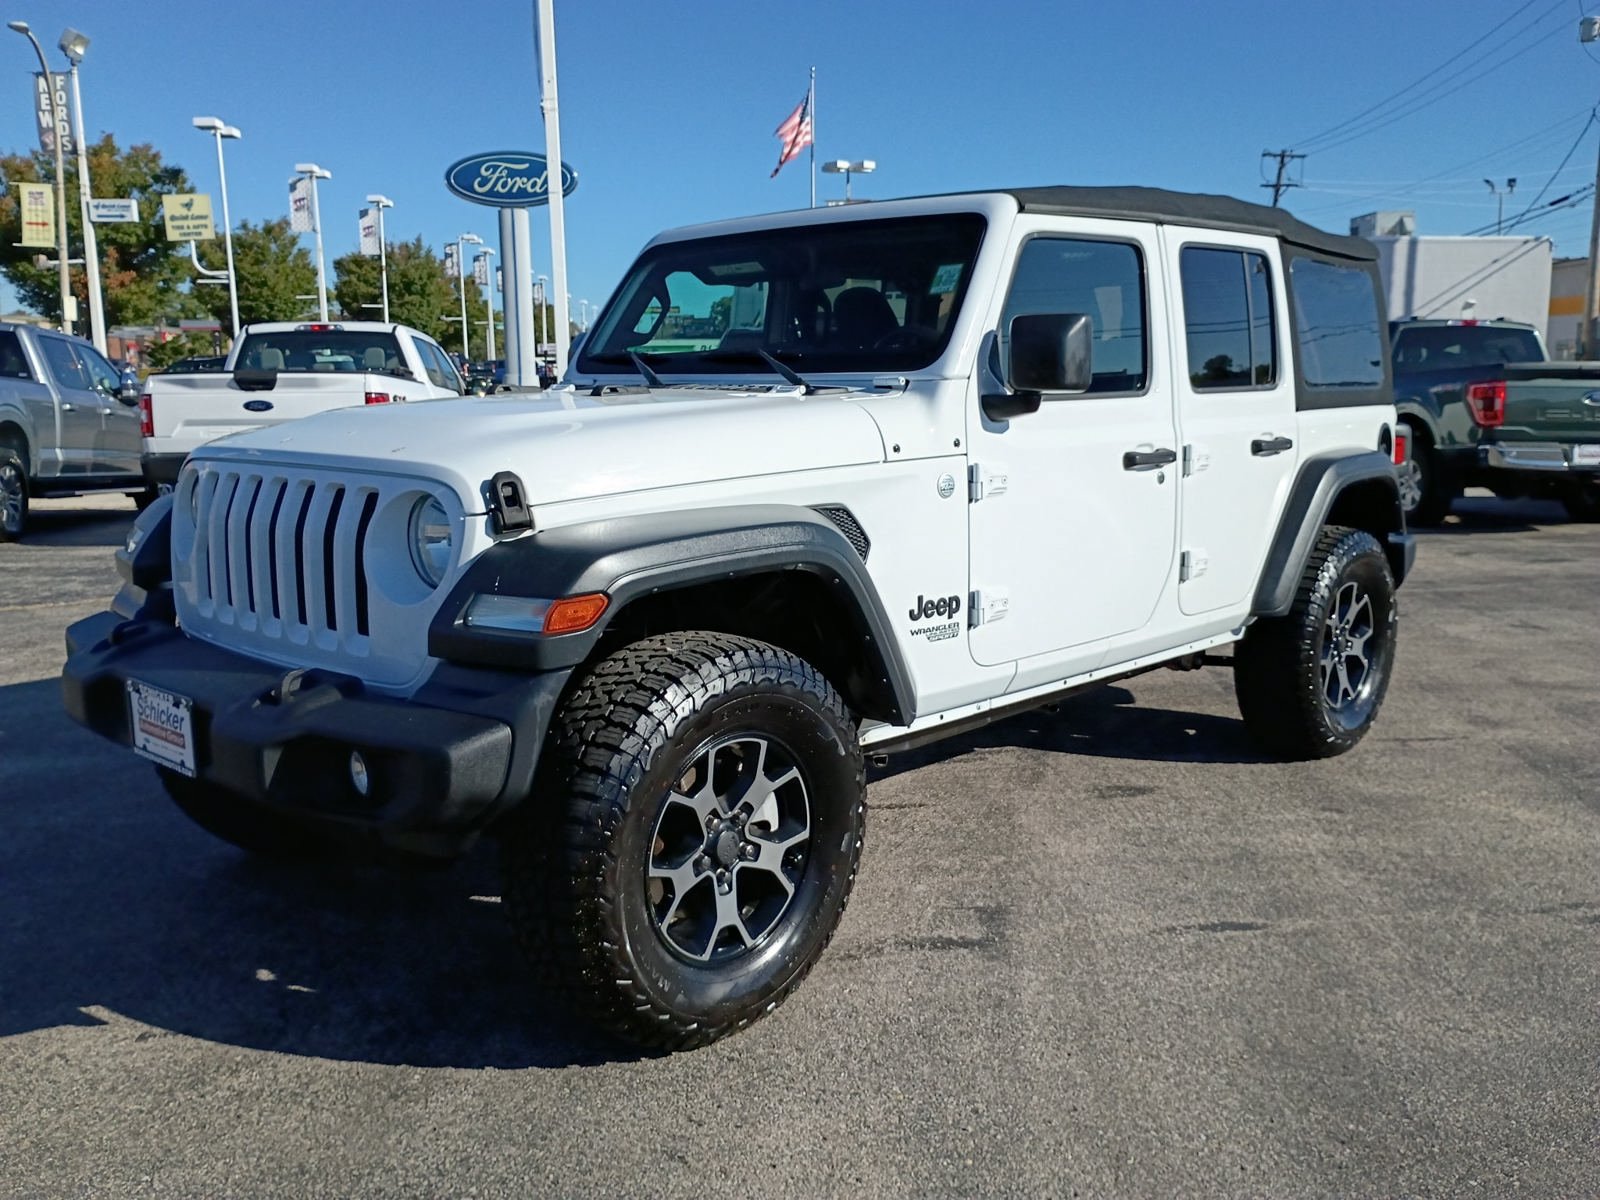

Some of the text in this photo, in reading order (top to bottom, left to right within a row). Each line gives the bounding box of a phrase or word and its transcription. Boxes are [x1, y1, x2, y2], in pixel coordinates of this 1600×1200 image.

[38, 76, 54, 129] NEW
[55, 75, 73, 152] FORDS
[473, 161, 548, 193] Ford
[909, 595, 961, 621] Jeep
[137, 697, 185, 731] Schicker
